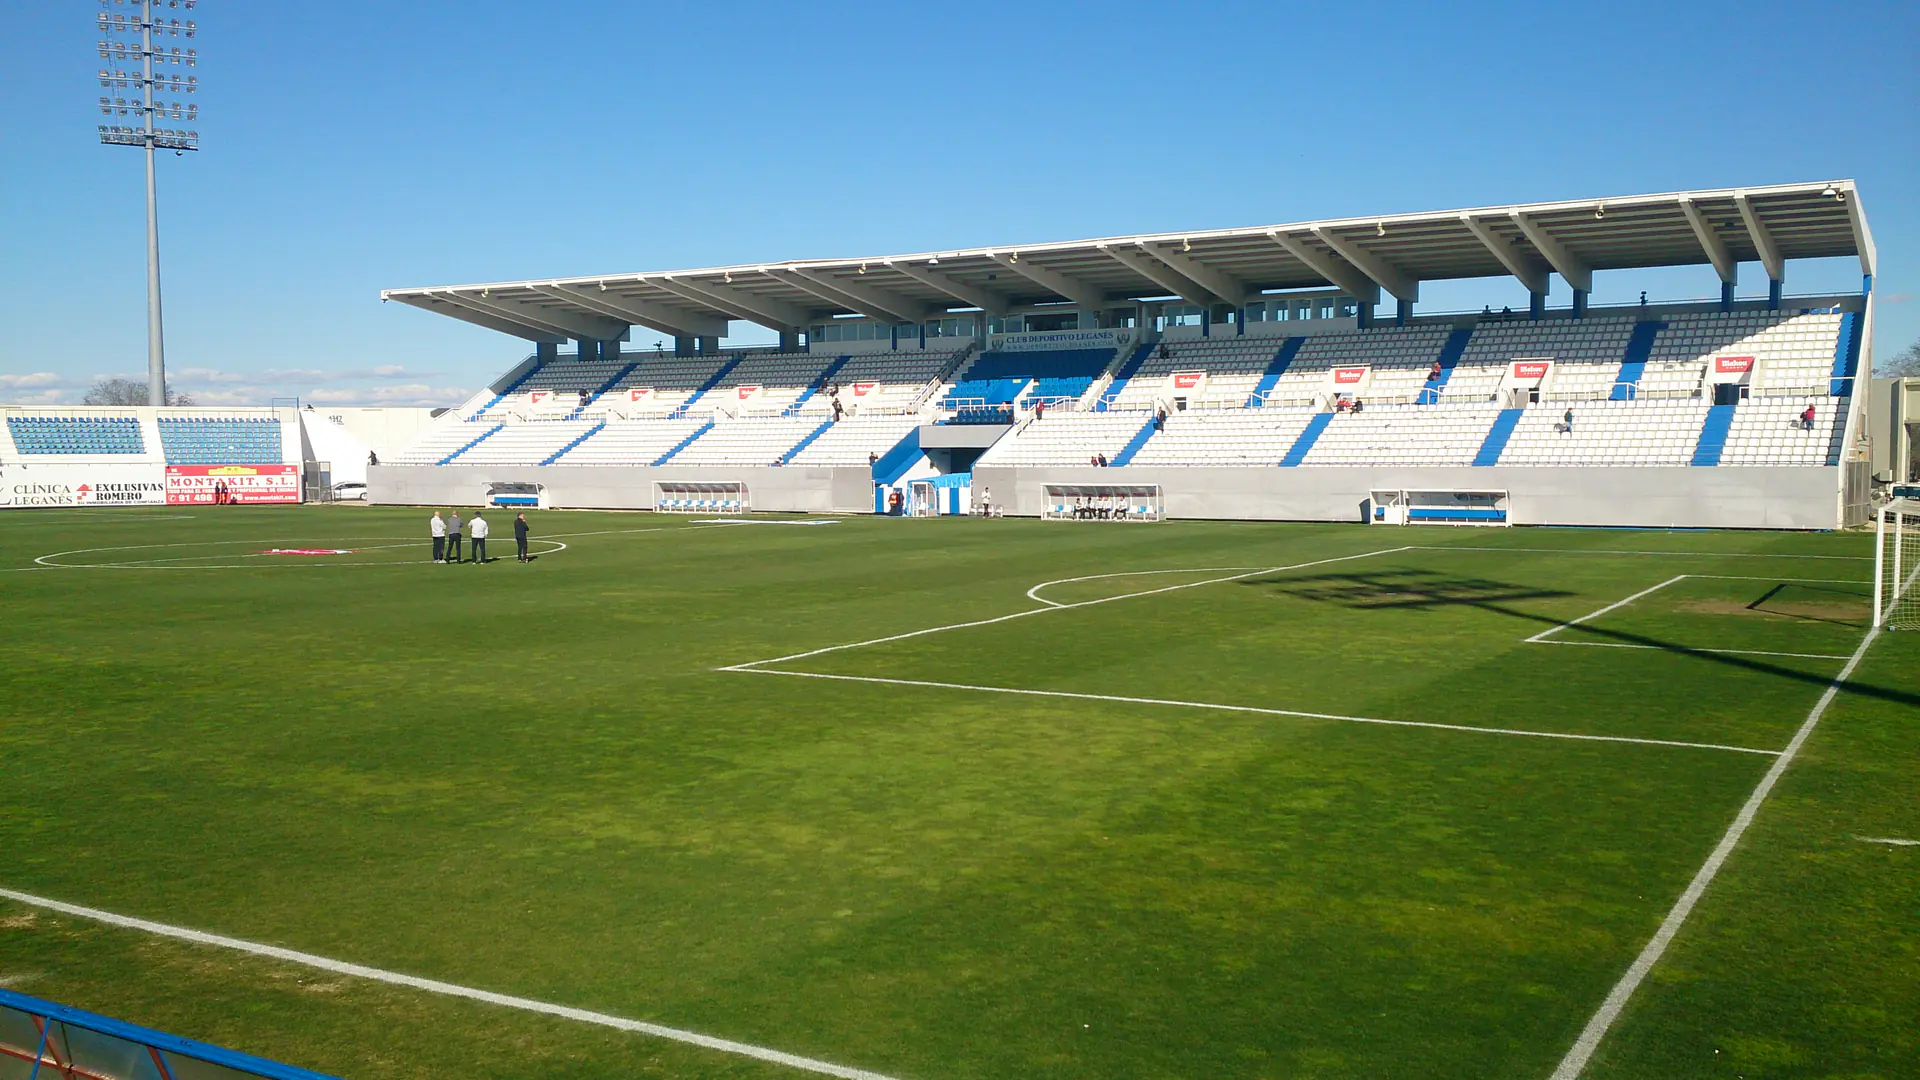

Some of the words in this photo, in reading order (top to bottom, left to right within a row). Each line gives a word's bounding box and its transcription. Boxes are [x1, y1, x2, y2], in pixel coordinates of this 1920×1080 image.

[1028, 334, 1075, 342] DEPORTIVO
[1075, 331, 1114, 340] LEGANÉS
[266, 477, 293, 486] S.L.
[14, 482, 71, 494] CLÍNICA
[96, 483, 164, 492] EXCLUSIVAS
[14, 494, 73, 505] LEGANÉS
[96, 492, 143, 501] ROMERO
[178, 494, 190, 502] 91
